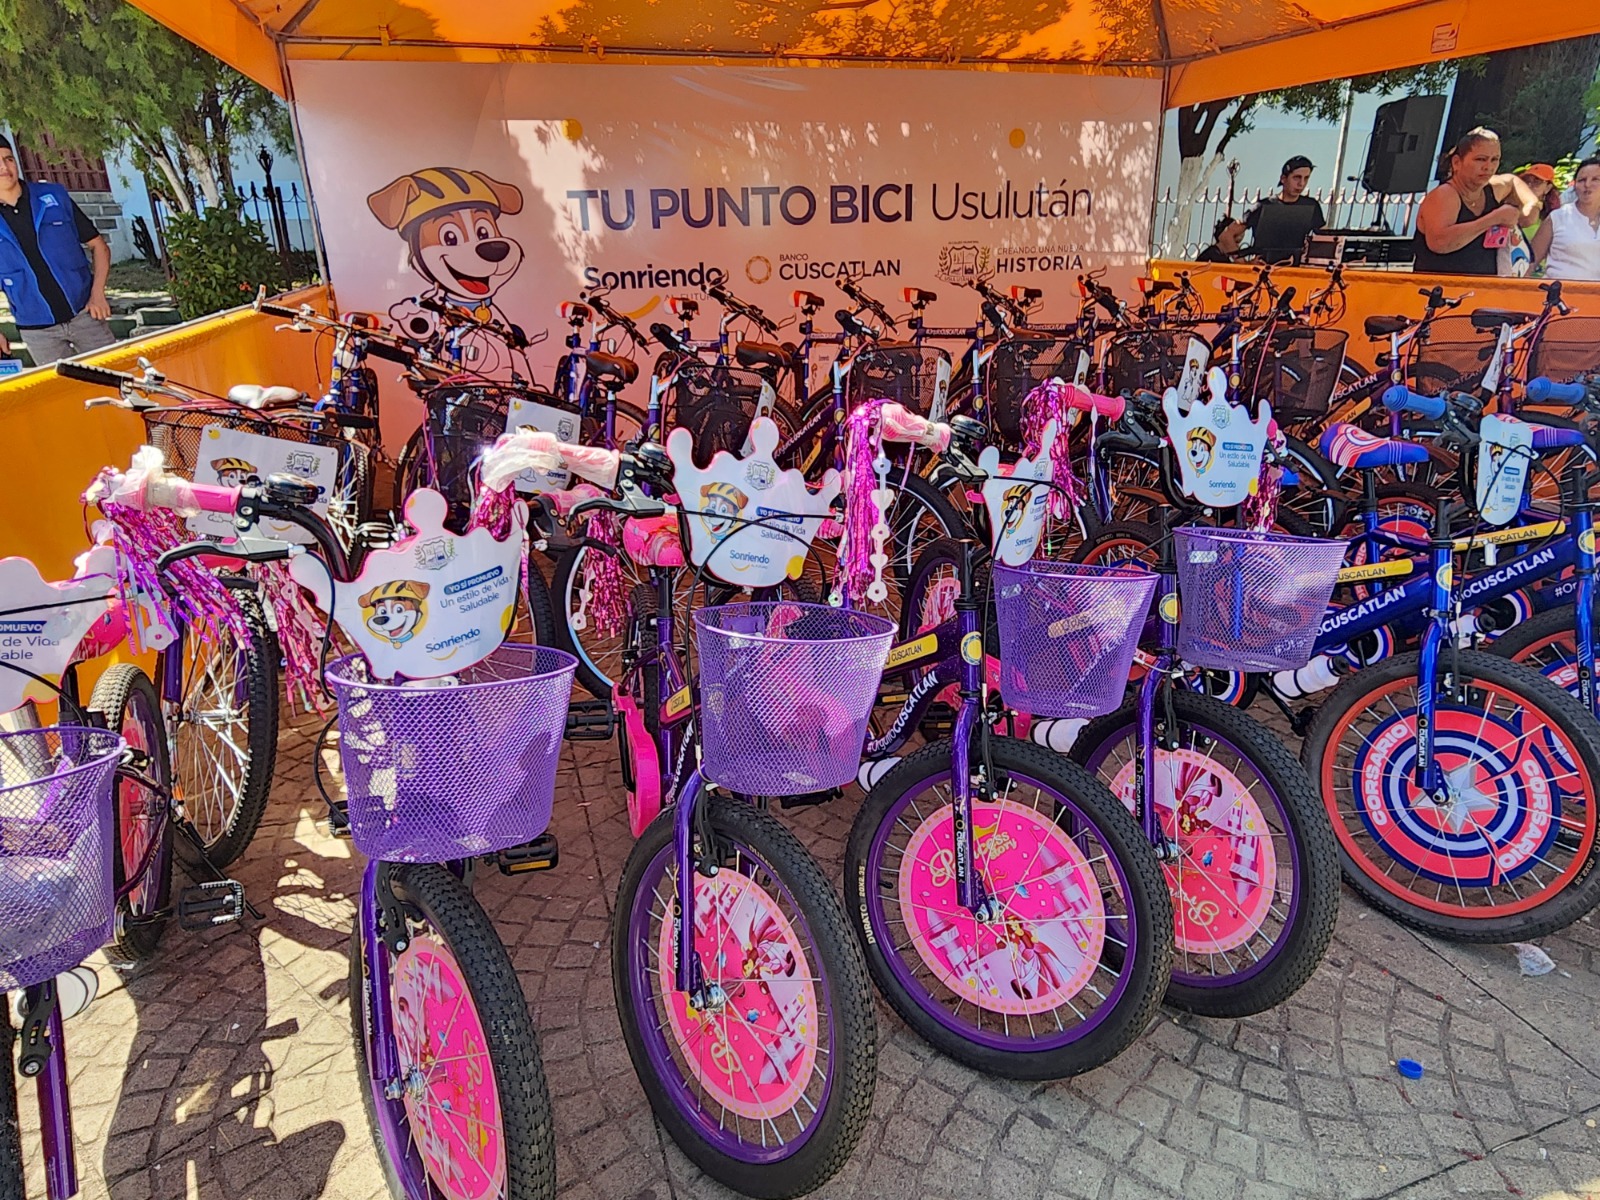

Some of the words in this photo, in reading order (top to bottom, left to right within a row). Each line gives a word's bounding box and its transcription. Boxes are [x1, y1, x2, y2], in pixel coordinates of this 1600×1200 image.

[566, 189, 635, 231] TU
[650, 186, 817, 229] PUNTO
[830, 184, 913, 224] BICI
[932, 179, 1092, 221] Usulután
[779, 254, 808, 262] BANCO
[998, 247, 1037, 256] CREANDO
[1039, 245, 1055, 254] UNA
[779, 259, 900, 281] CUSCATLAN
[997, 255, 1083, 273] HISTORIA
[584, 262, 723, 290] Sonriendo
[1208, 480, 1236, 489] Sonriendo
[791, 525, 806, 536] Vida
[729, 550, 770, 565] Sonriendo
[440, 599, 454, 608] Un
[457, 589, 480, 604] estilo
[482, 584, 492, 594] de
[493, 576, 509, 588] Vida
[459, 592, 500, 613] Saludable
[2, 636, 22, 647] de
[425, 627, 481, 653] Sonriendo
[891, 643, 923, 663] CUSCATLAN
[1364, 724, 1409, 827] CORSARIO
[1498, 759, 1549, 870] CORSARIO
[956, 831, 965, 877] CUSCATLAN
[859, 903, 876, 945] DURATO
